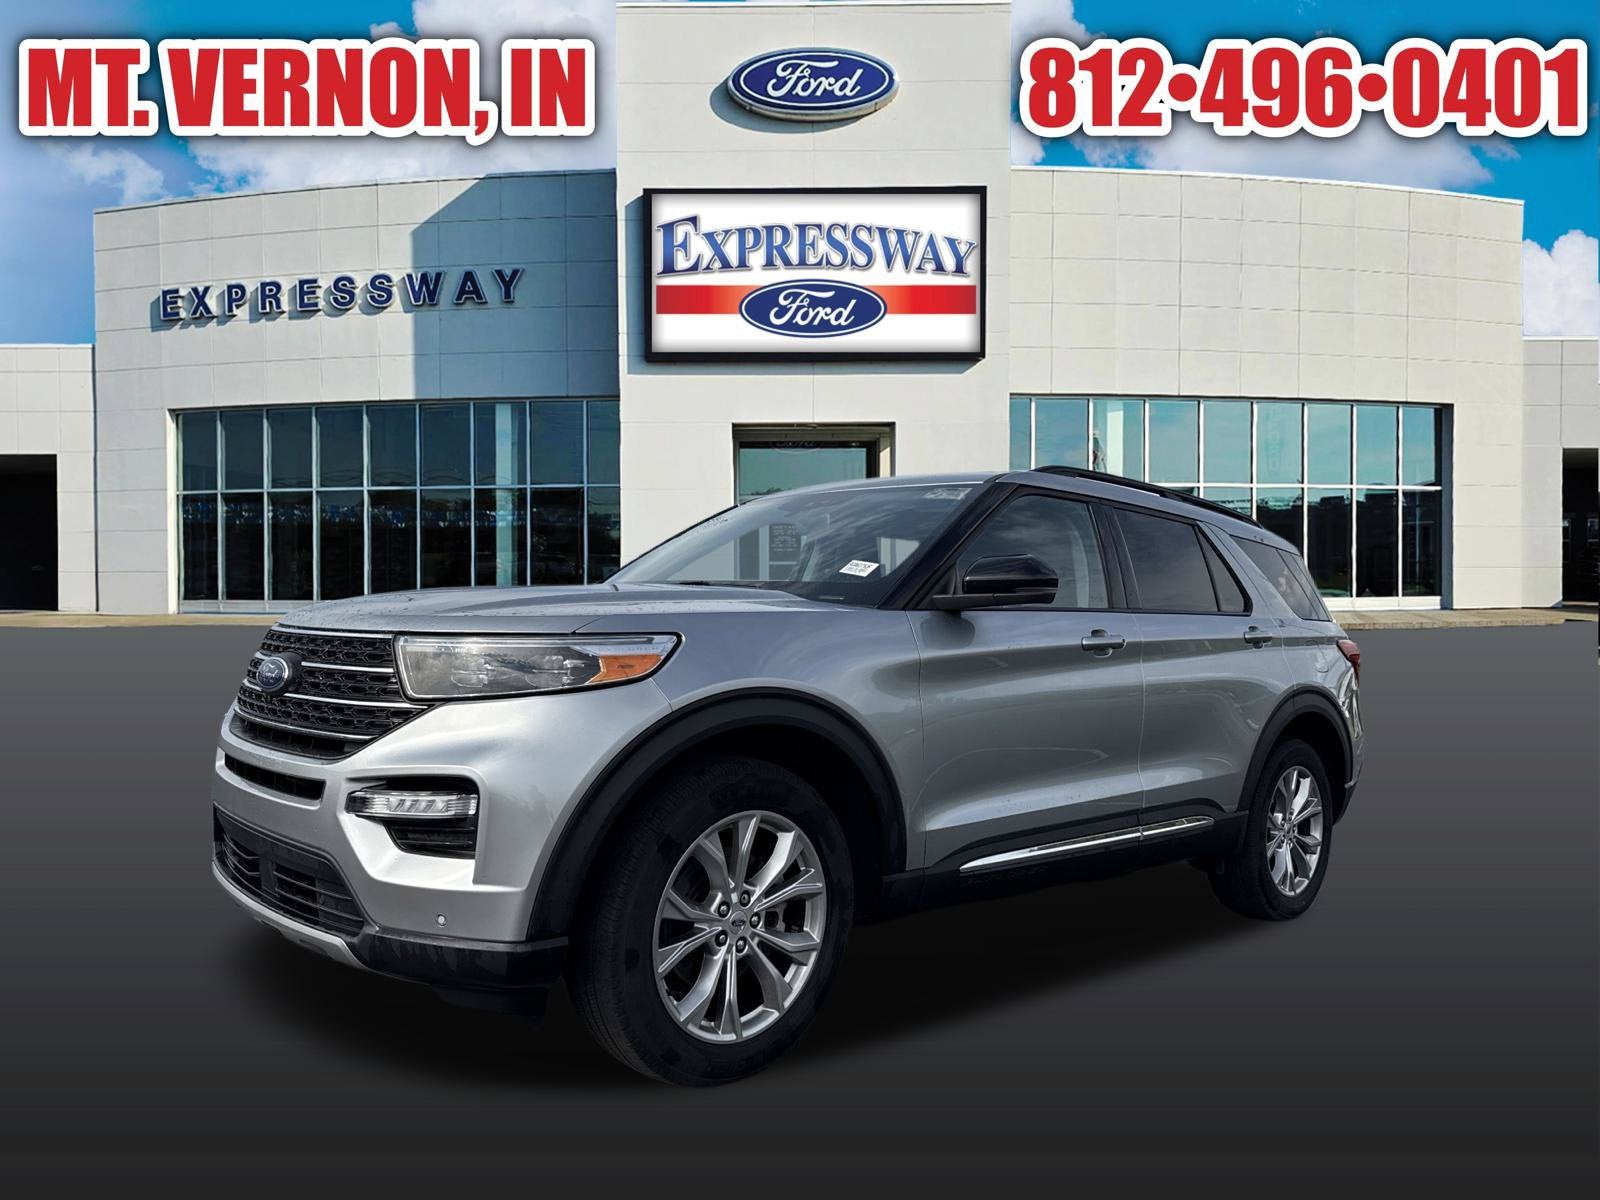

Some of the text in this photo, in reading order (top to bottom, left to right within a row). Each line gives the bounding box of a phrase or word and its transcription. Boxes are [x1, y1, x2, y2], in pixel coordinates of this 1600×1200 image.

[766, 59, 864, 98] Ford
[655, 213, 979, 279] EXPRESSWAY
[159, 268, 525, 321] EXPRESSWAY
[769, 288, 858, 328] Ford
